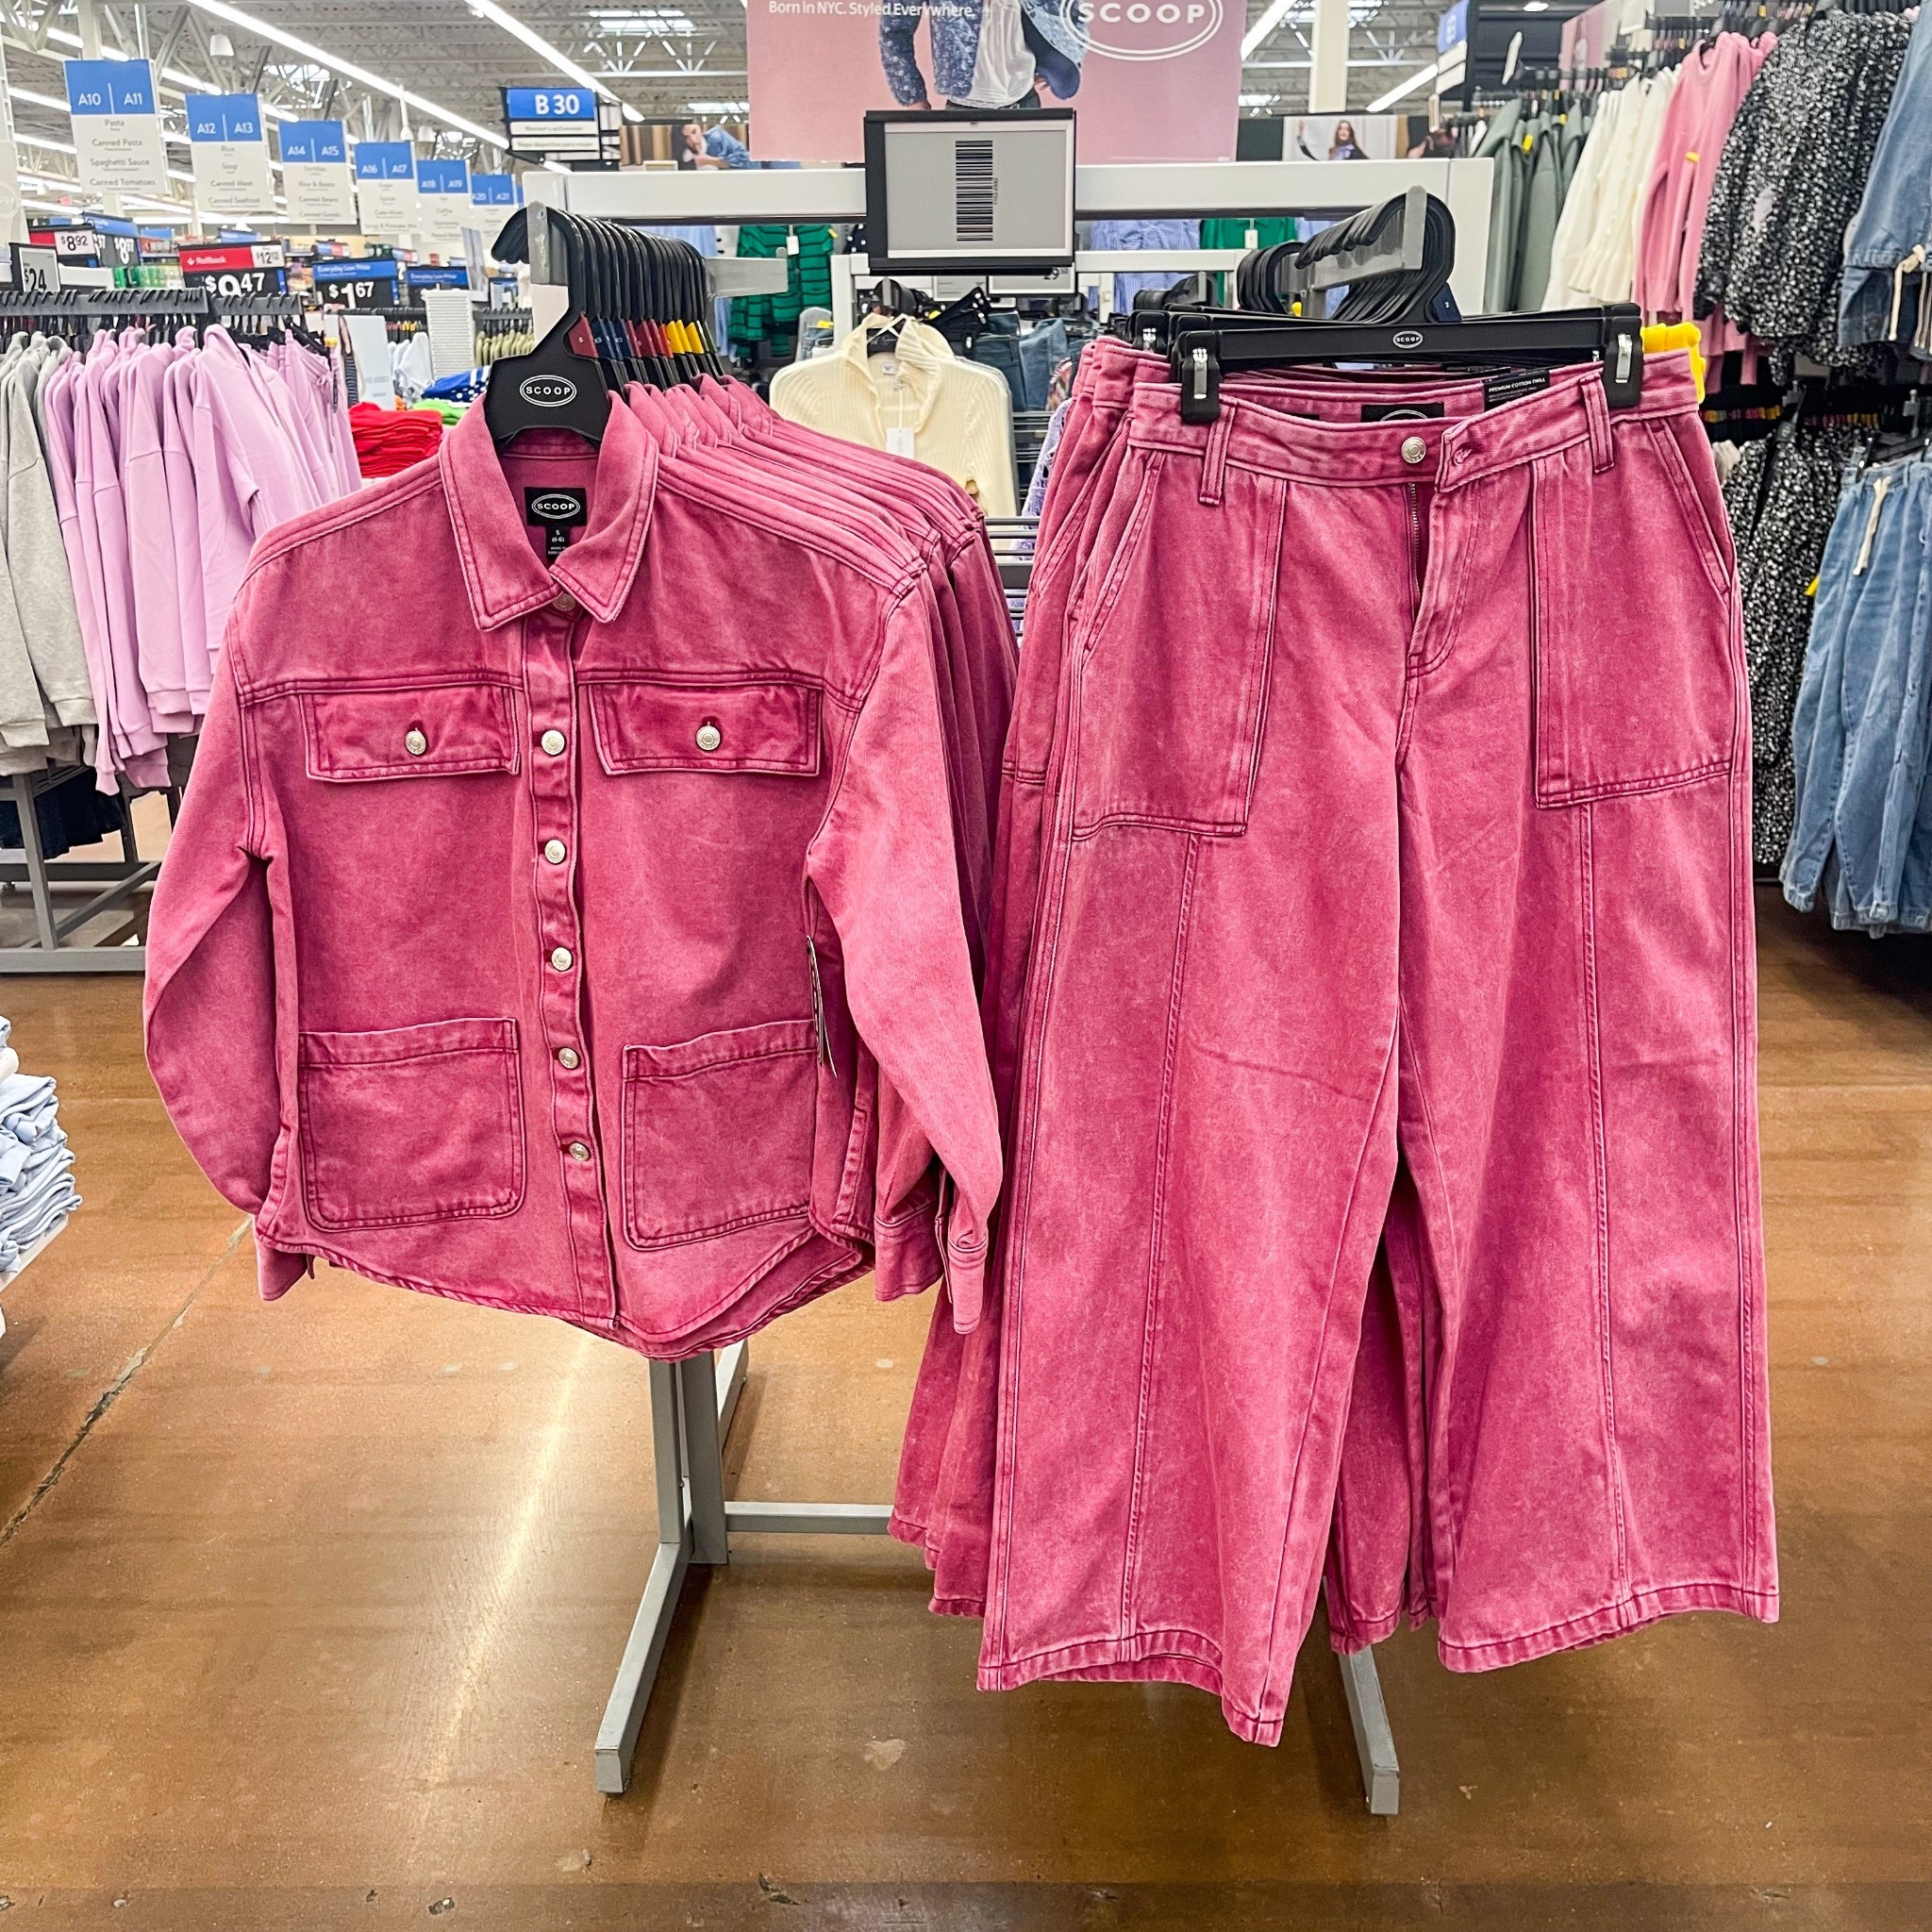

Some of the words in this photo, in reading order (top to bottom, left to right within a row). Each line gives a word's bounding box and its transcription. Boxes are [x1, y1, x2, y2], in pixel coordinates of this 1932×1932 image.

[769, 1, 800, 14] Born
[802, 1, 815, 14] in
[817, 3, 847, 15] NYC.
[849, 2, 893, 18] Styled
[893, 2, 975, 18] Everywhere.
[1077, 3, 1206, 25] SCOOP
[78, 92, 101, 106] A10
[124, 92, 142, 106] A11
[534, 93, 550, 115] B
[552, 93, 580, 115] 30
[196, 123, 216, 134] A12
[234, 122, 254, 134] A13
[91, 158, 126, 167] Spaghetti
[525, 385, 571, 395] SCOOP
[1489, 384, 1511, 392] PREMIUM
[1511, 380, 1531, 389] COTTON
